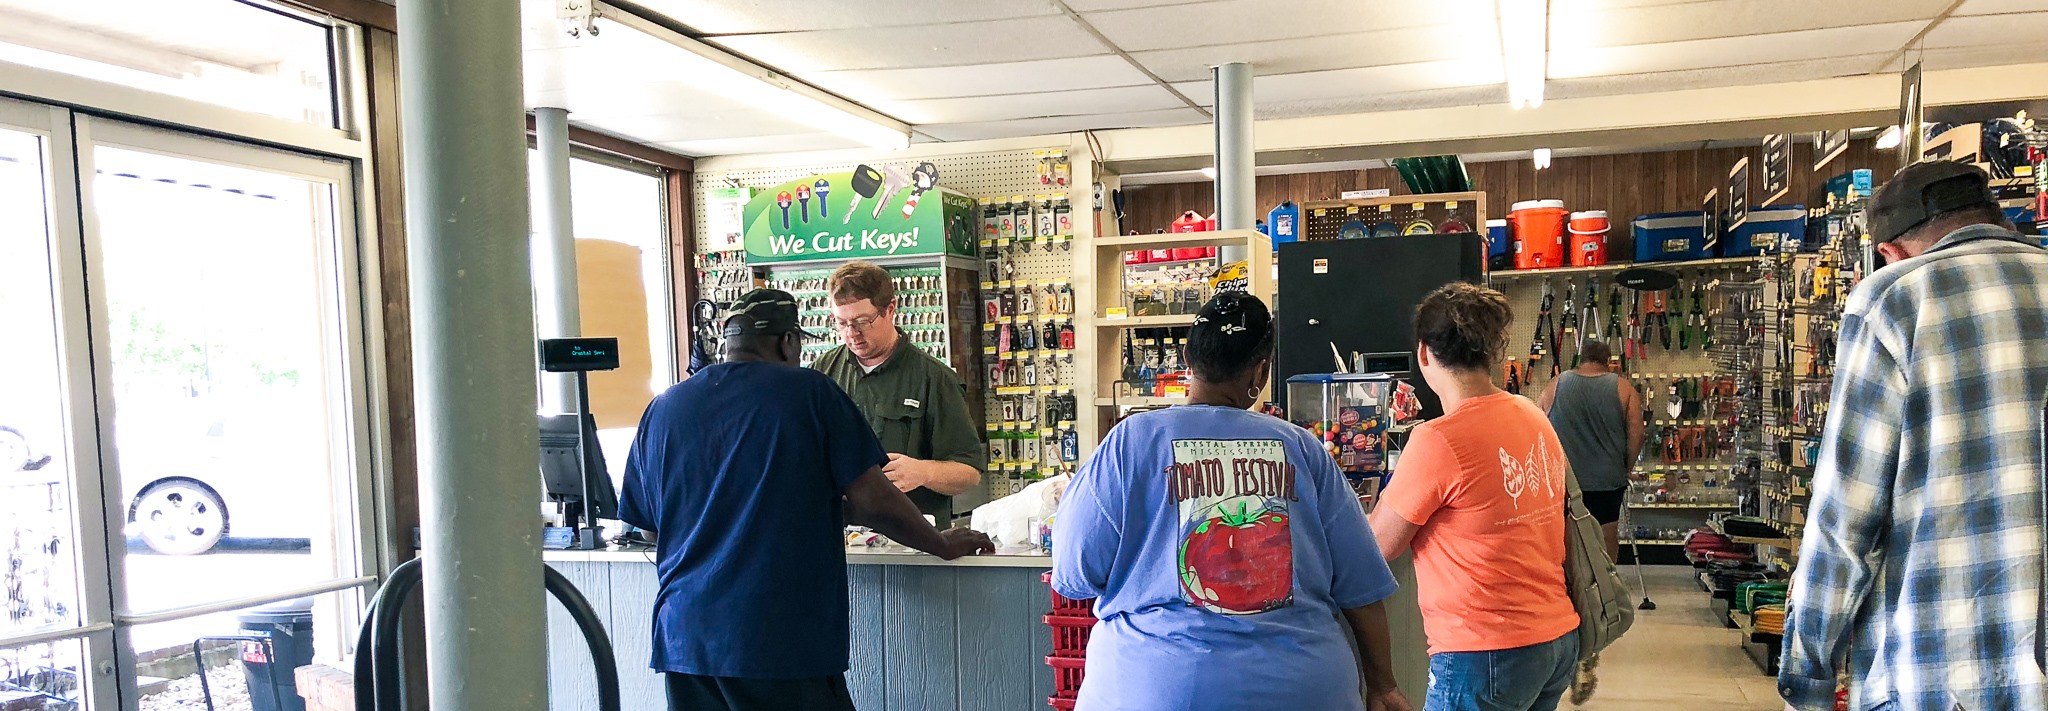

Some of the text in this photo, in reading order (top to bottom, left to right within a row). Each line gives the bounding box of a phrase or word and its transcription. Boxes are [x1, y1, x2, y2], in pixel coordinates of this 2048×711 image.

[1904, 83, 1915, 148] 4
[768, 226, 920, 256] We Cut Keys!
[1217, 277, 1248, 288] Chips
[1174, 440, 1283, 449] CRYSTAL SPRINGS
[1190, 448, 1274, 456] MISSISSIPPI
[1164, 458, 1300, 505] TOMATO FESTIVAL
